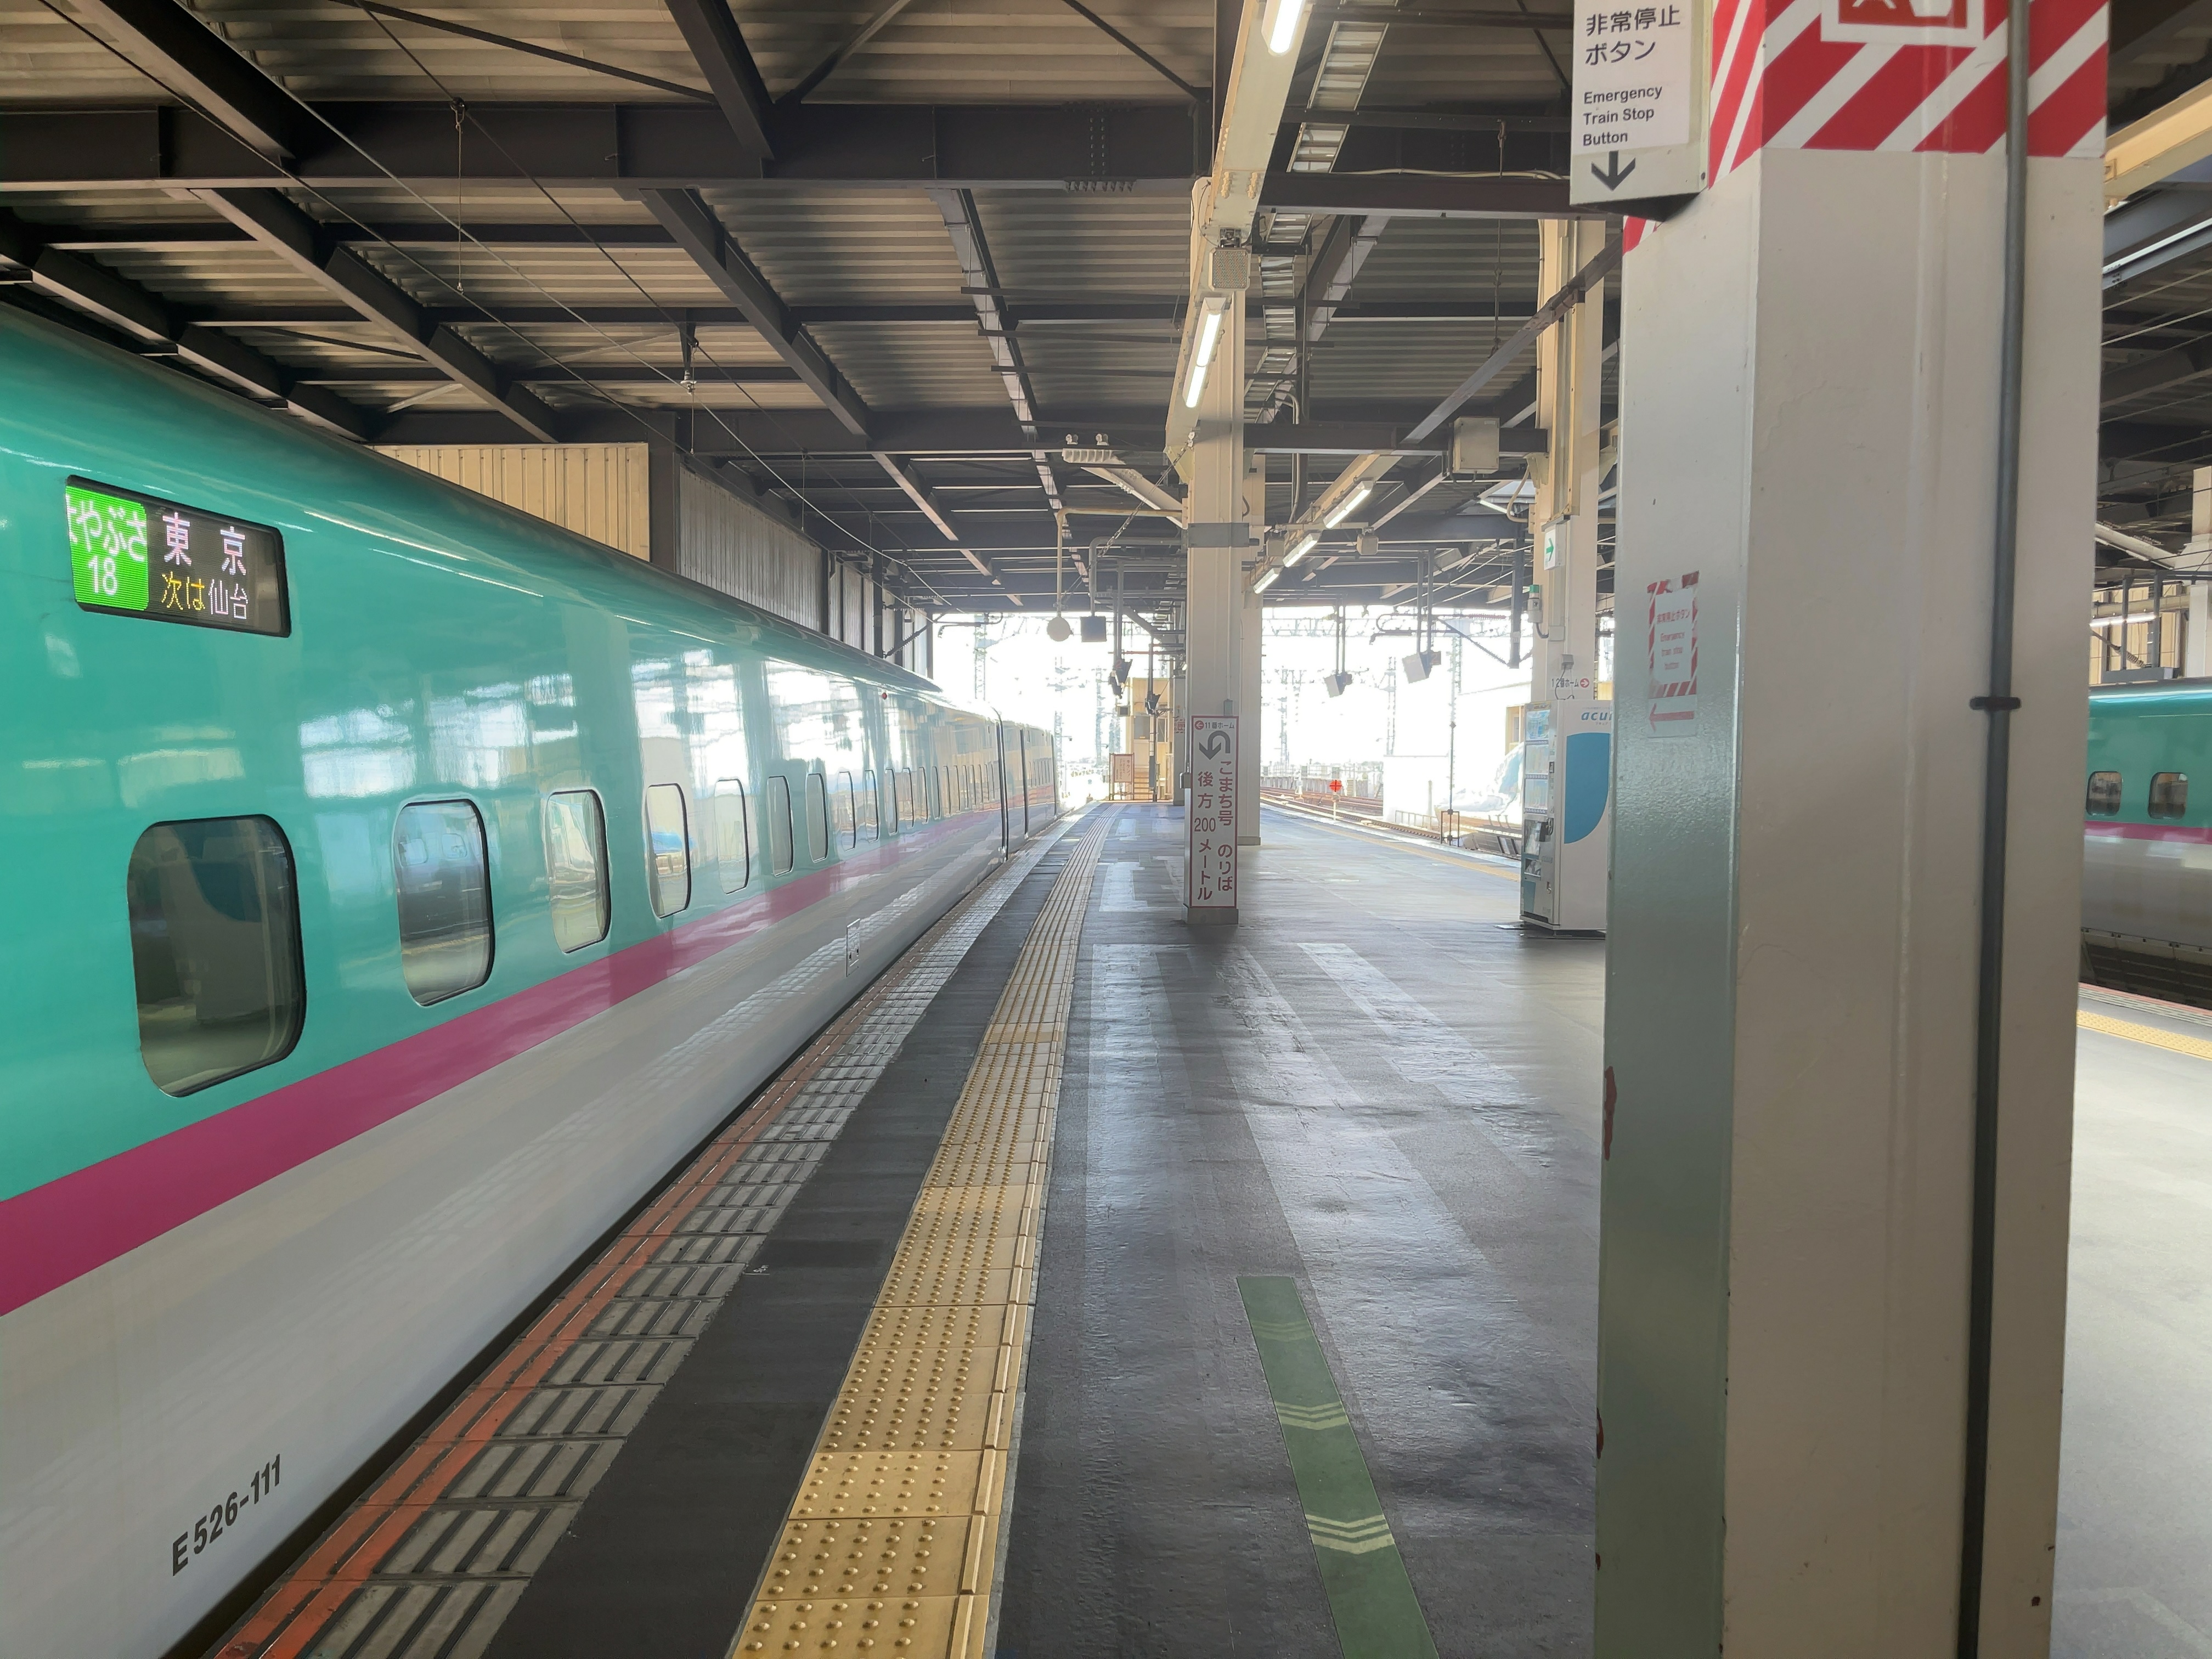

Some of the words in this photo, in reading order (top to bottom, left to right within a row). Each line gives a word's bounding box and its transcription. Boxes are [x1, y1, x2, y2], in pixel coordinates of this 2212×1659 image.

[1585, 4, 1681, 36] 非常停止
[1585, 40, 1656, 66] ボタン
[1583, 86, 1663, 105] Emergency
[1583, 110, 1618, 126] Train
[1622, 108, 1655, 122] Stop
[1583, 131, 1628, 146] Button
[88, 555, 119, 596] 18
[161, 571, 249, 620] 次は仙台
[1218, 760, 1233, 826] こまち号
[1217, 844, 1233, 891] のりば
